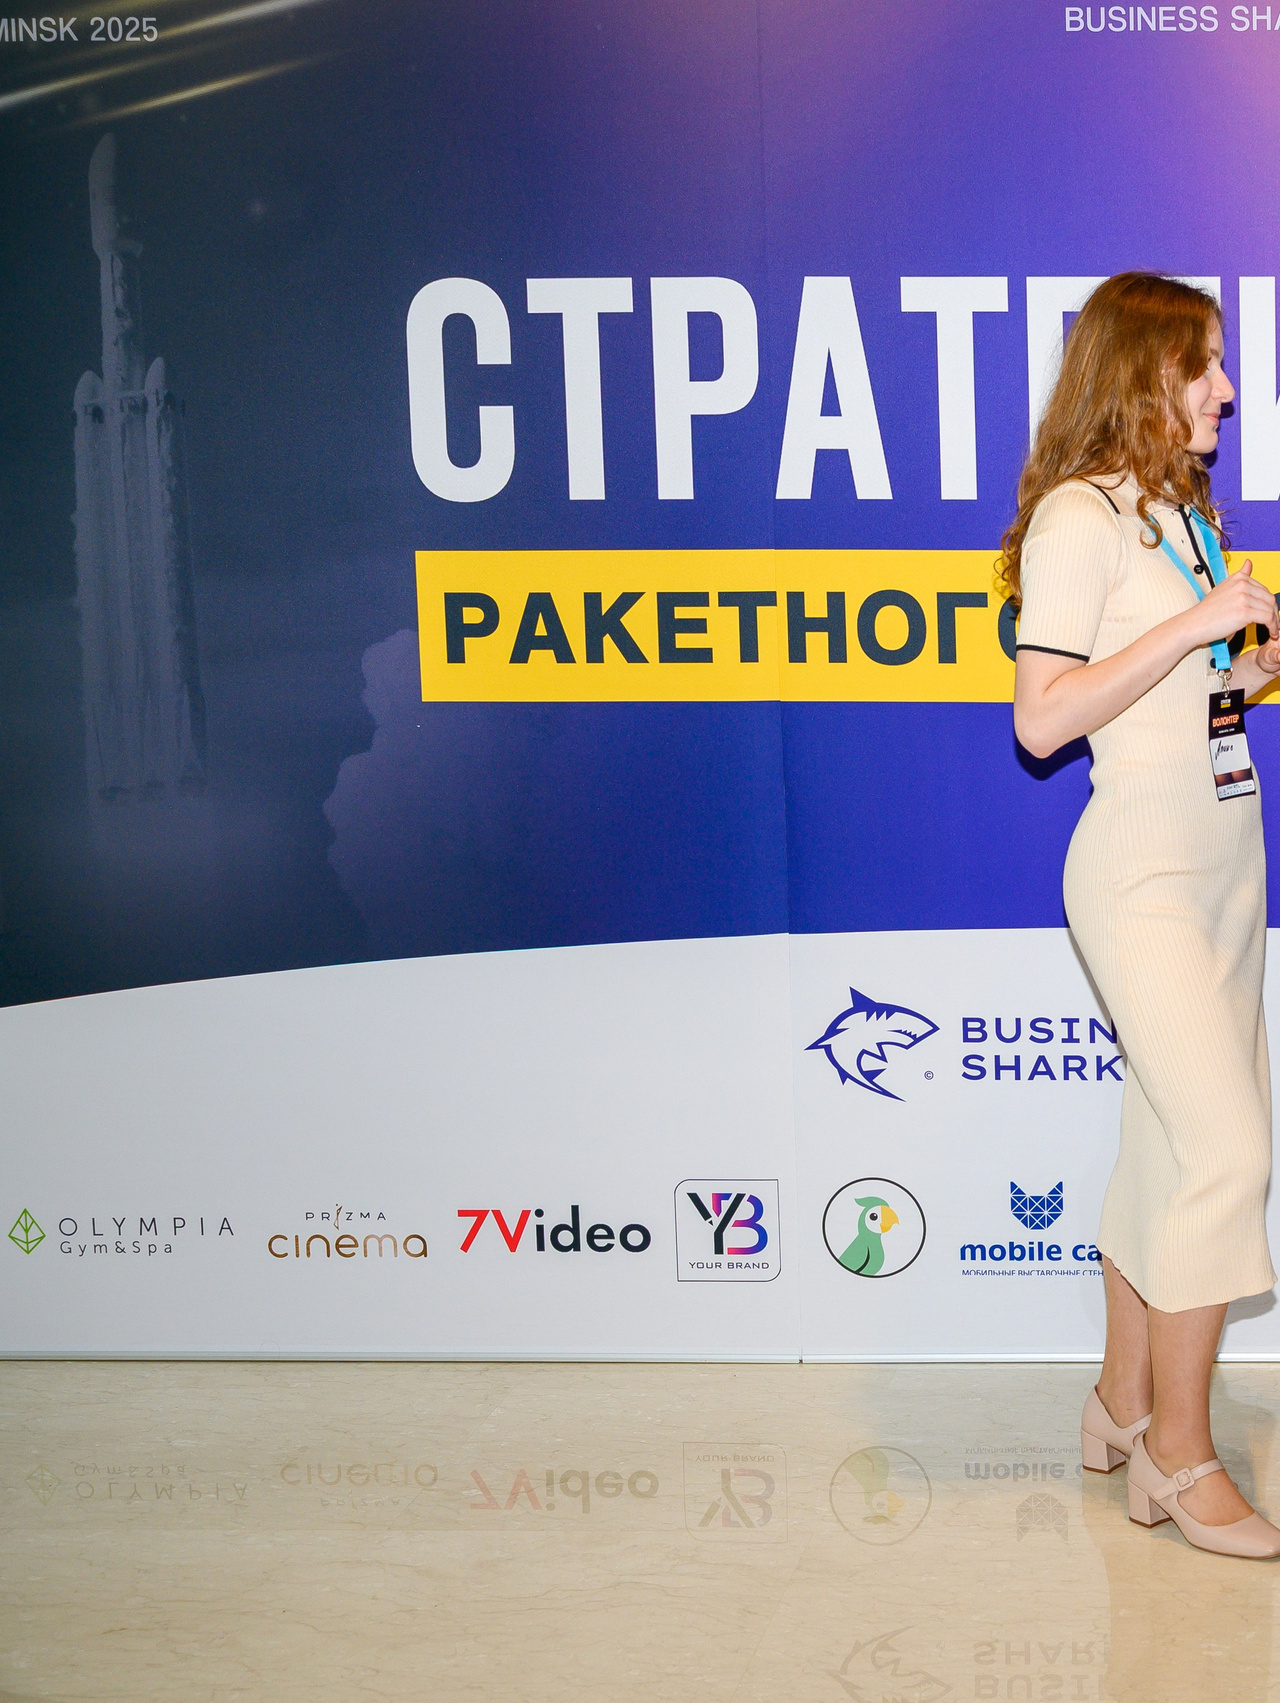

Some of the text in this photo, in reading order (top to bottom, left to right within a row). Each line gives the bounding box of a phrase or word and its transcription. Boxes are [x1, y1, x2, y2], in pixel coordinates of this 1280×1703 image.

[90, 17, 158, 42] 2025
[1065, 6, 1219, 32] BUSINESS
[443, 588, 1020, 667] РАКЕТНОГ
[1212, 714, 1239, 728] ВОЛОНТЕР
[961, 1054, 1124, 1081] SHARK
[58, 1217, 234, 1237] OLYMPIA
[305, 1203, 386, 1231] PRIZMA
[457, 1205, 652, 1252] 7Video
[60, 1241, 173, 1257] Gym&Spa
[268, 1233, 428, 1258] cinema
[960, 1241, 1062, 1261] mobile
[689, 1261, 770, 1269] YOUR BRAND
